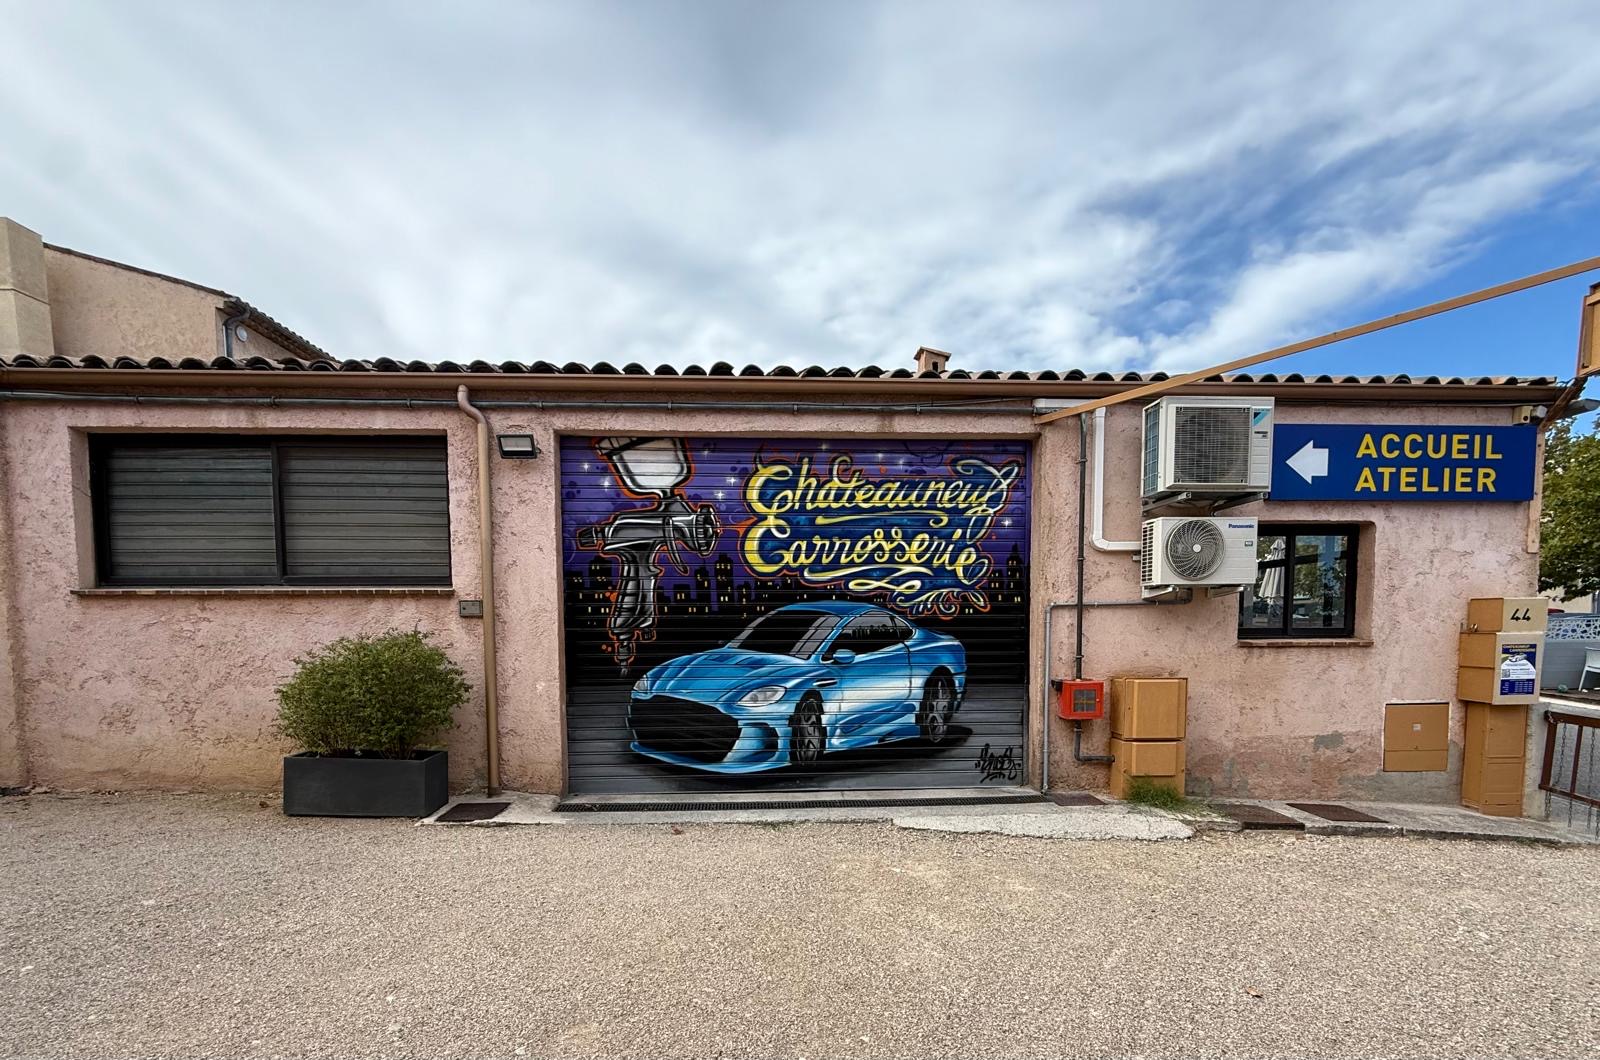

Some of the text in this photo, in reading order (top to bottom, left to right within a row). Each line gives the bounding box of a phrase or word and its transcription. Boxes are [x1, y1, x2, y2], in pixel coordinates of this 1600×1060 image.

[1356, 433, 1502, 459] ACCUEIL
[1355, 467, 1496, 492] ATELIER
[744, 518, 988, 585] Carrosserie
[1510, 608, 1531, 621] 44
